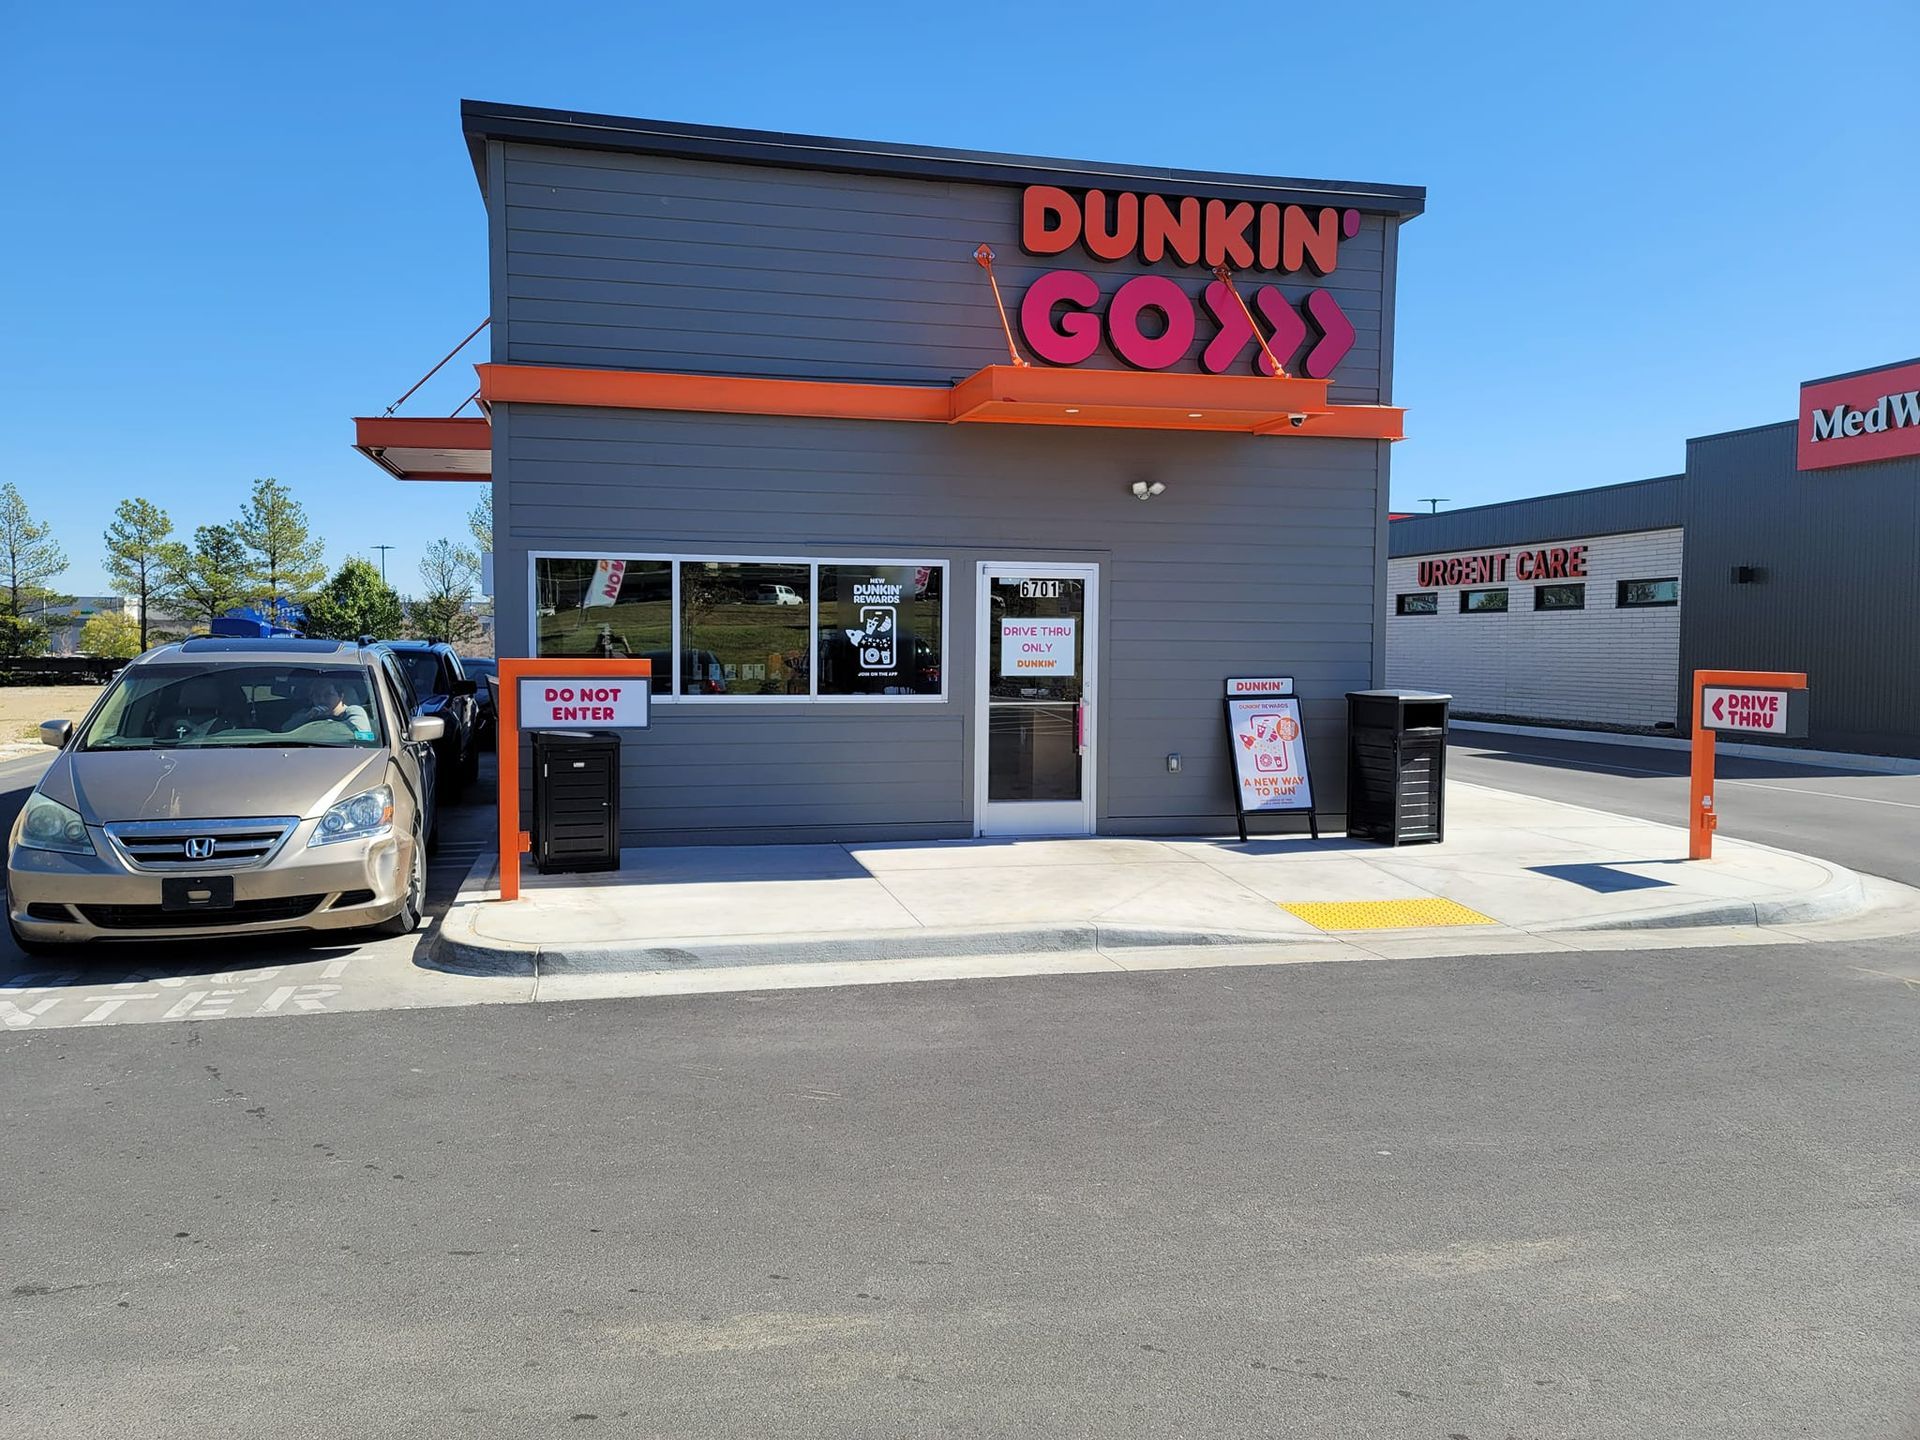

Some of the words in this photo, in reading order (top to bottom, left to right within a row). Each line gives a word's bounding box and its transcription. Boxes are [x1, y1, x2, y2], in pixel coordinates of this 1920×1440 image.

[1023, 185, 1361, 275] DUNKIN'
[1020, 269, 1196, 370] GO
[1417, 553, 1510, 588] URGENT
[1516, 546, 1588, 581] CARE
[853, 584, 902, 595] DUNKIN'
[1021, 581, 1058, 597] 6701
[853, 595, 900, 604] REWARDS
[1003, 626, 1037, 636] DRIVE
[1041, 626, 1072, 636] THRU
[1022, 643, 1053, 653] ONLY
[1017, 660, 1057, 668] DUNKIN'
[1236, 681, 1284, 692] DUNKIN'
[545, 688, 575, 702] DO
[579, 688, 622, 702] NOT
[1727, 694, 1779, 713] DRIVE
[552, 707, 615, 721] ENTER
[1727, 710, 1774, 729] THRU
[1243, 778, 1252, 787] A
[1254, 777, 1279, 787] NEW
[1281, 776, 1305, 786] WAY
[1255, 787, 1271, 797] TO
[1273, 786, 1297, 796] RUN
